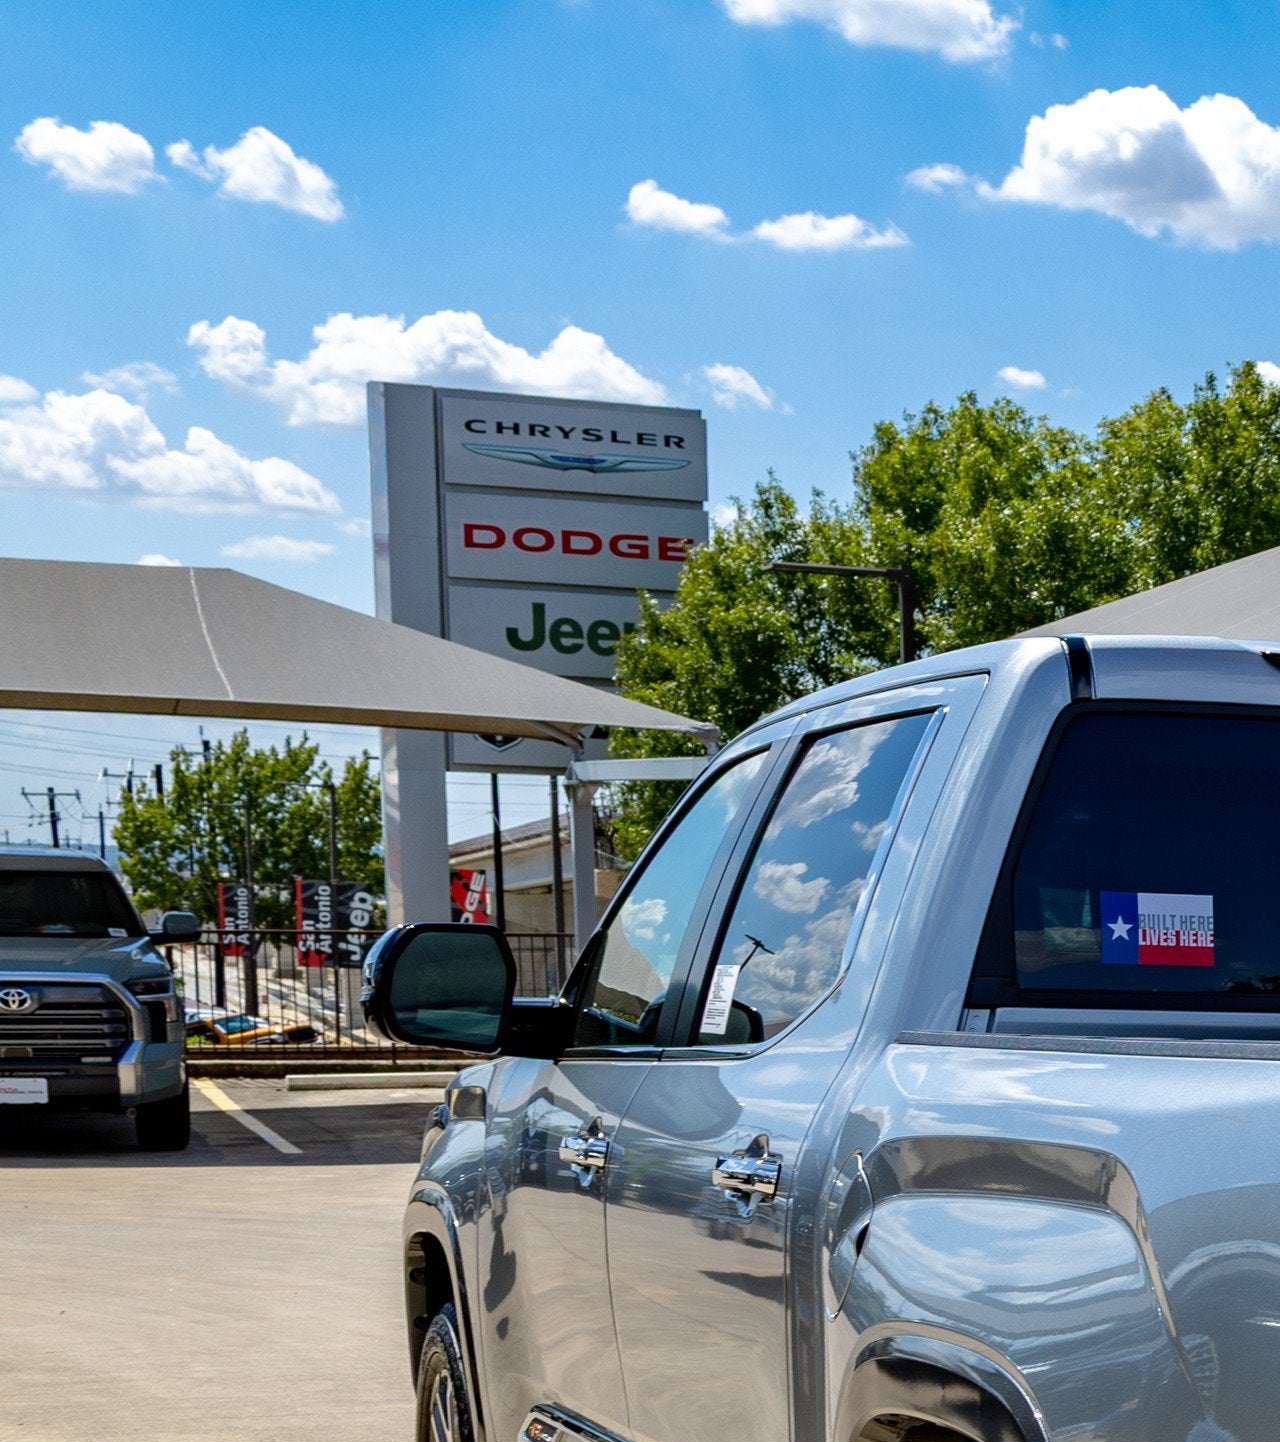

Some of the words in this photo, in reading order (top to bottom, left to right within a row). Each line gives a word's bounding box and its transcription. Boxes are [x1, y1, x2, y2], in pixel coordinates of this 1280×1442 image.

[464, 419, 686, 449] CHRYSLER
[463, 523, 695, 562] DODGE
[506, 602, 636, 657] Jee
[338, 891, 375, 961] Jeep
[1138, 914, 1176, 930] BUILT
[1180, 915, 1213, 931] HERE
[1138, 929, 1177, 947] LIVES
[1180, 930, 1215, 947] HERE
